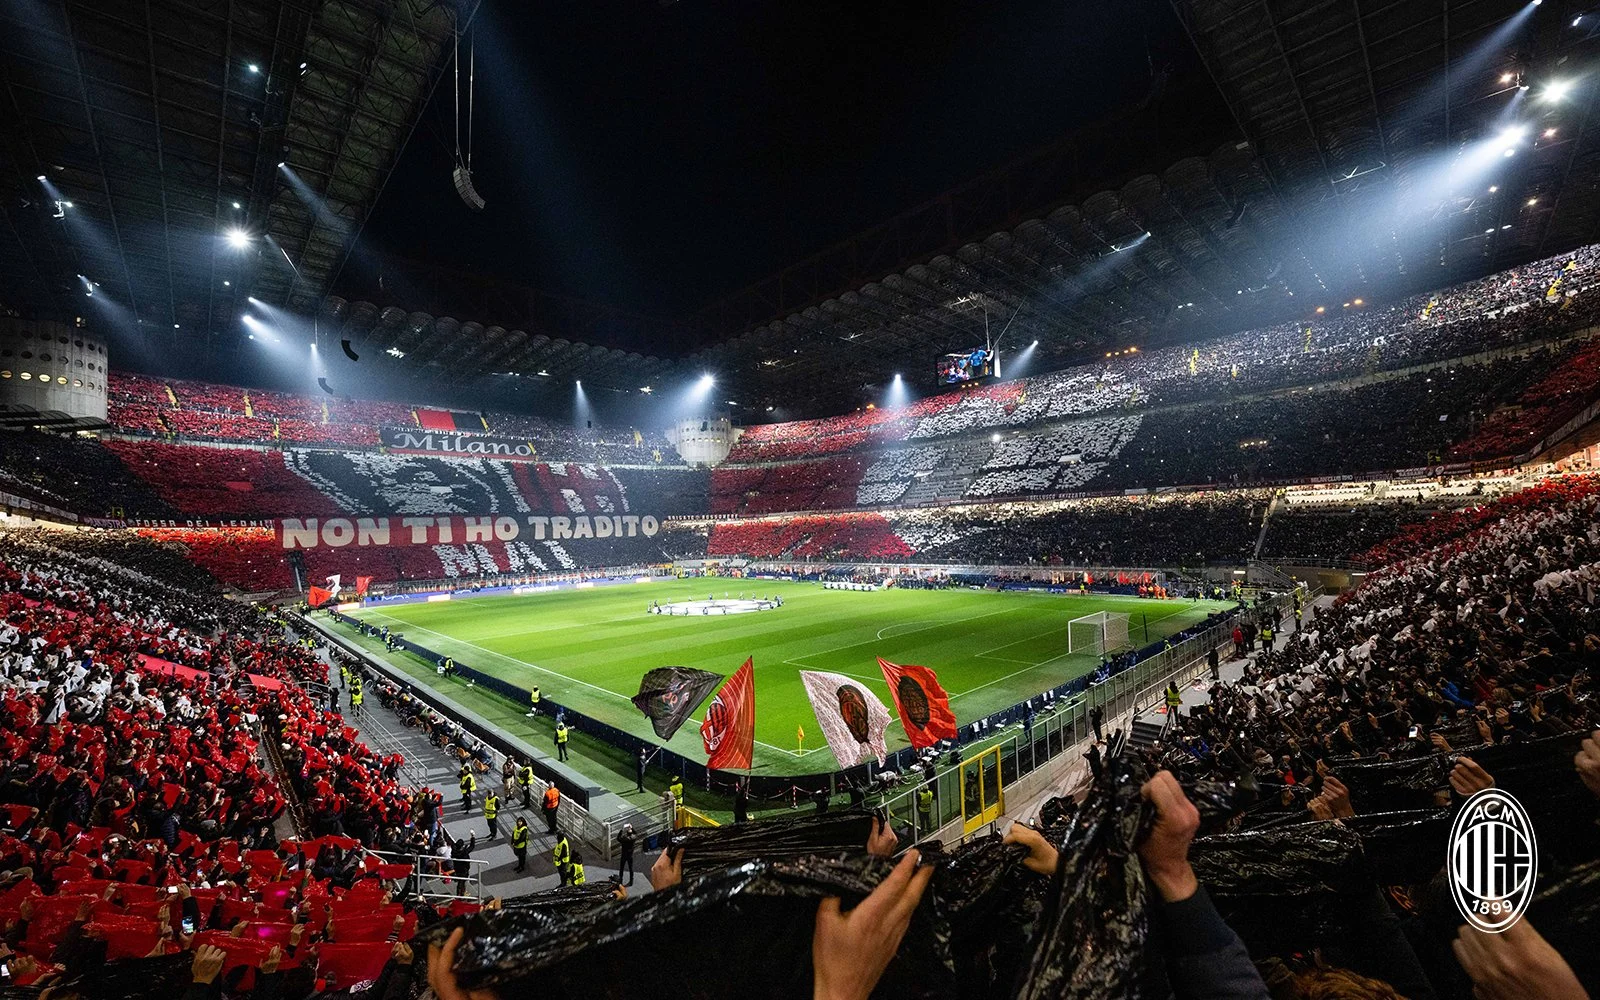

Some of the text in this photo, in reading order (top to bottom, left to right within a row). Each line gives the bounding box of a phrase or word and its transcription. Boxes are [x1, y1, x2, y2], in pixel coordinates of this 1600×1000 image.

[391, 432, 531, 456] Milano
[136, 519, 177, 527] FOSSA
[186, 519, 209, 527] DEI
[220, 519, 264, 527] LEONI
[281, 514, 660, 549] NON TI HO TRADITO
